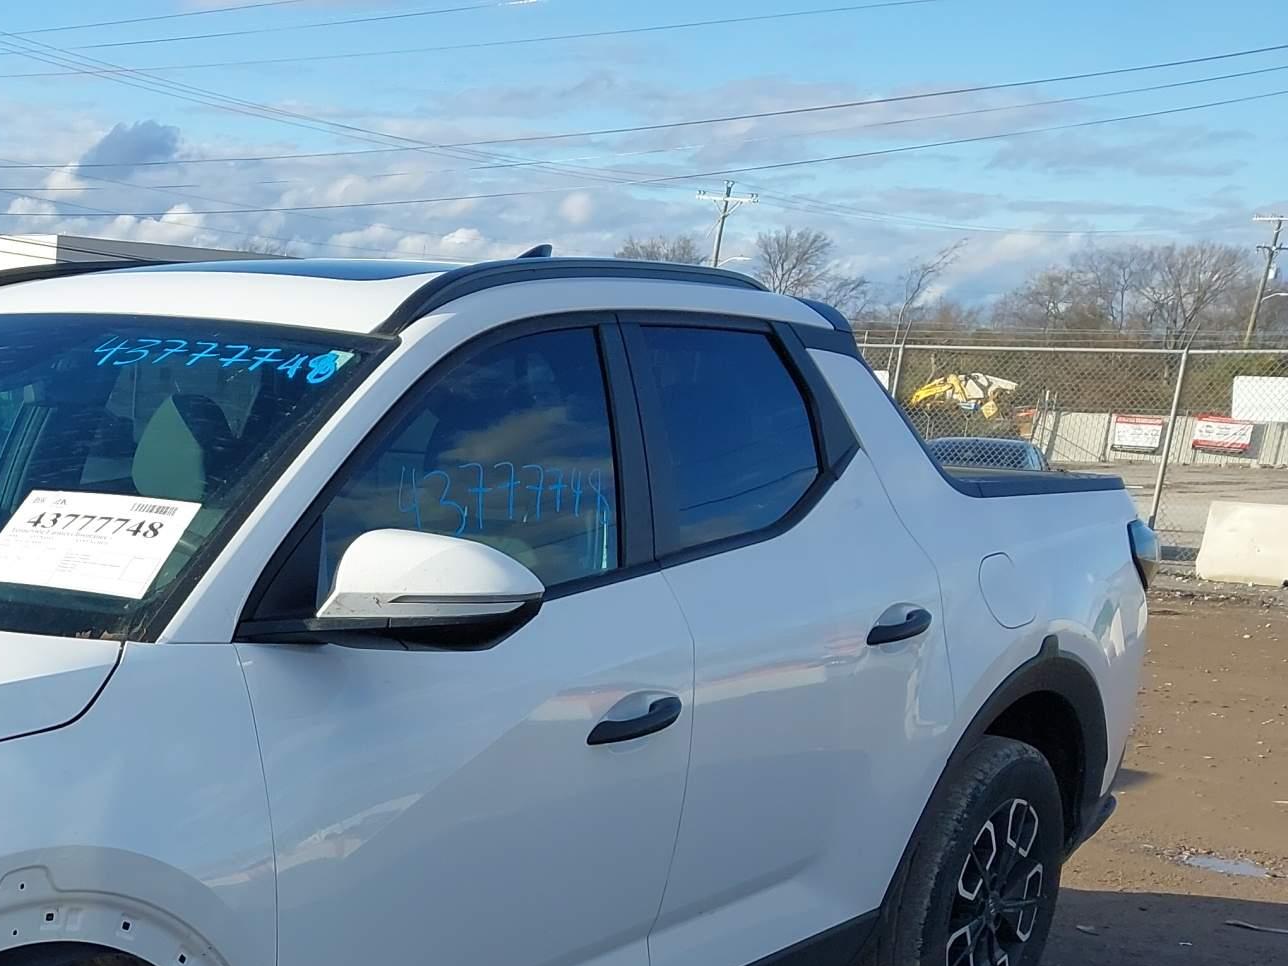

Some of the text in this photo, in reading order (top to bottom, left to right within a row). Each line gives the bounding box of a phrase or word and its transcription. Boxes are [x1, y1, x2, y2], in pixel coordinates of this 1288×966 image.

[94, 335, 340, 384] 43777748
[398, 462, 610, 536] 43777748
[26, 511, 165, 539] 43777748
